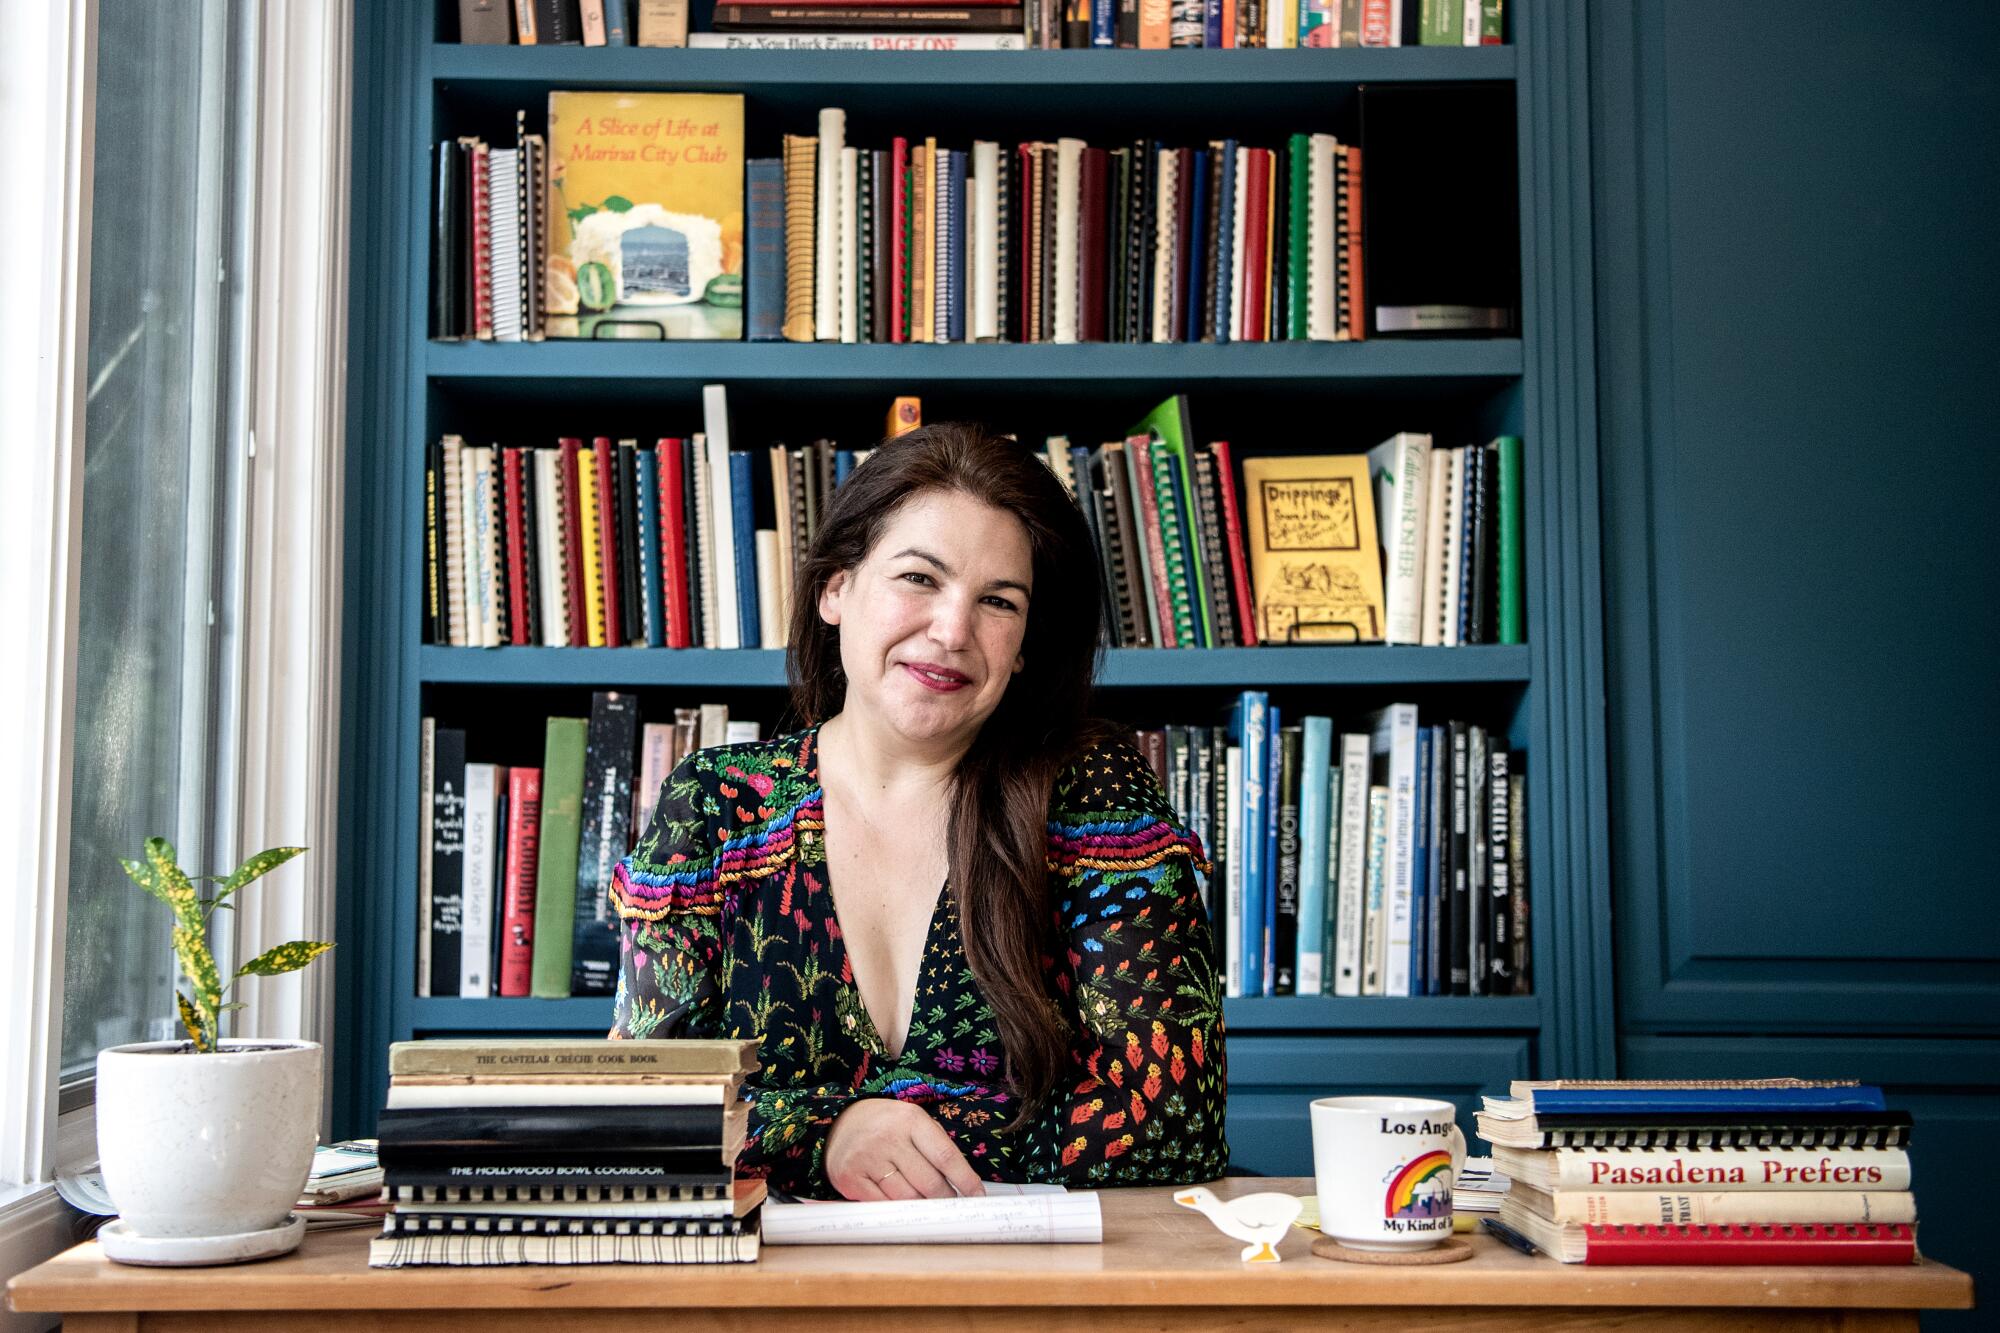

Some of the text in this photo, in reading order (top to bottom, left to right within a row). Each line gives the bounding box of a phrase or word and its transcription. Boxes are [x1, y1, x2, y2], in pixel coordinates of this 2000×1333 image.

[725, 36, 753, 49] The
[826, 36, 869, 49] Times
[872, 37, 918, 49] PAGE
[922, 37, 959, 49] ONE
[576, 116, 720, 140] A Slice of Life at
[570, 143, 729, 167] Marina City Club
[1397, 508, 1418, 578] KOSHER
[1348, 763, 1363, 819] REYNER
[1398, 776, 1410, 794] THE
[522, 799, 538, 830] BIG
[595, 766, 617, 922] THE BROAD COLLECTION
[1345, 824, 1360, 891] BANHAM
[1366, 794, 1389, 912] Los Angeles
[470, 811, 488, 927] kara walker
[1278, 804, 1298, 917] LLOYD WRIGHT
[518, 835, 536, 917] GOODBYE
[476, 1055, 496, 1064] THE
[501, 1055, 550, 1064] CASTELAR
[598, 1054, 625, 1064] COOK
[630, 1054, 658, 1063] BOOK
[1381, 1118, 1416, 1135] Los
[451, 1166, 665, 1176] THE HOLLYWOOD BOWL COOKBOOK
[1588, 1157, 1883, 1185] Pasadena Prefers
[1660, 1195, 1674, 1224] BURNT
[1677, 1195, 1692, 1224] TOAST
[1384, 1219, 1405, 1234] My
[1407, 1219, 1436, 1232] Kind
[1438, 1217, 1447, 1229] of
